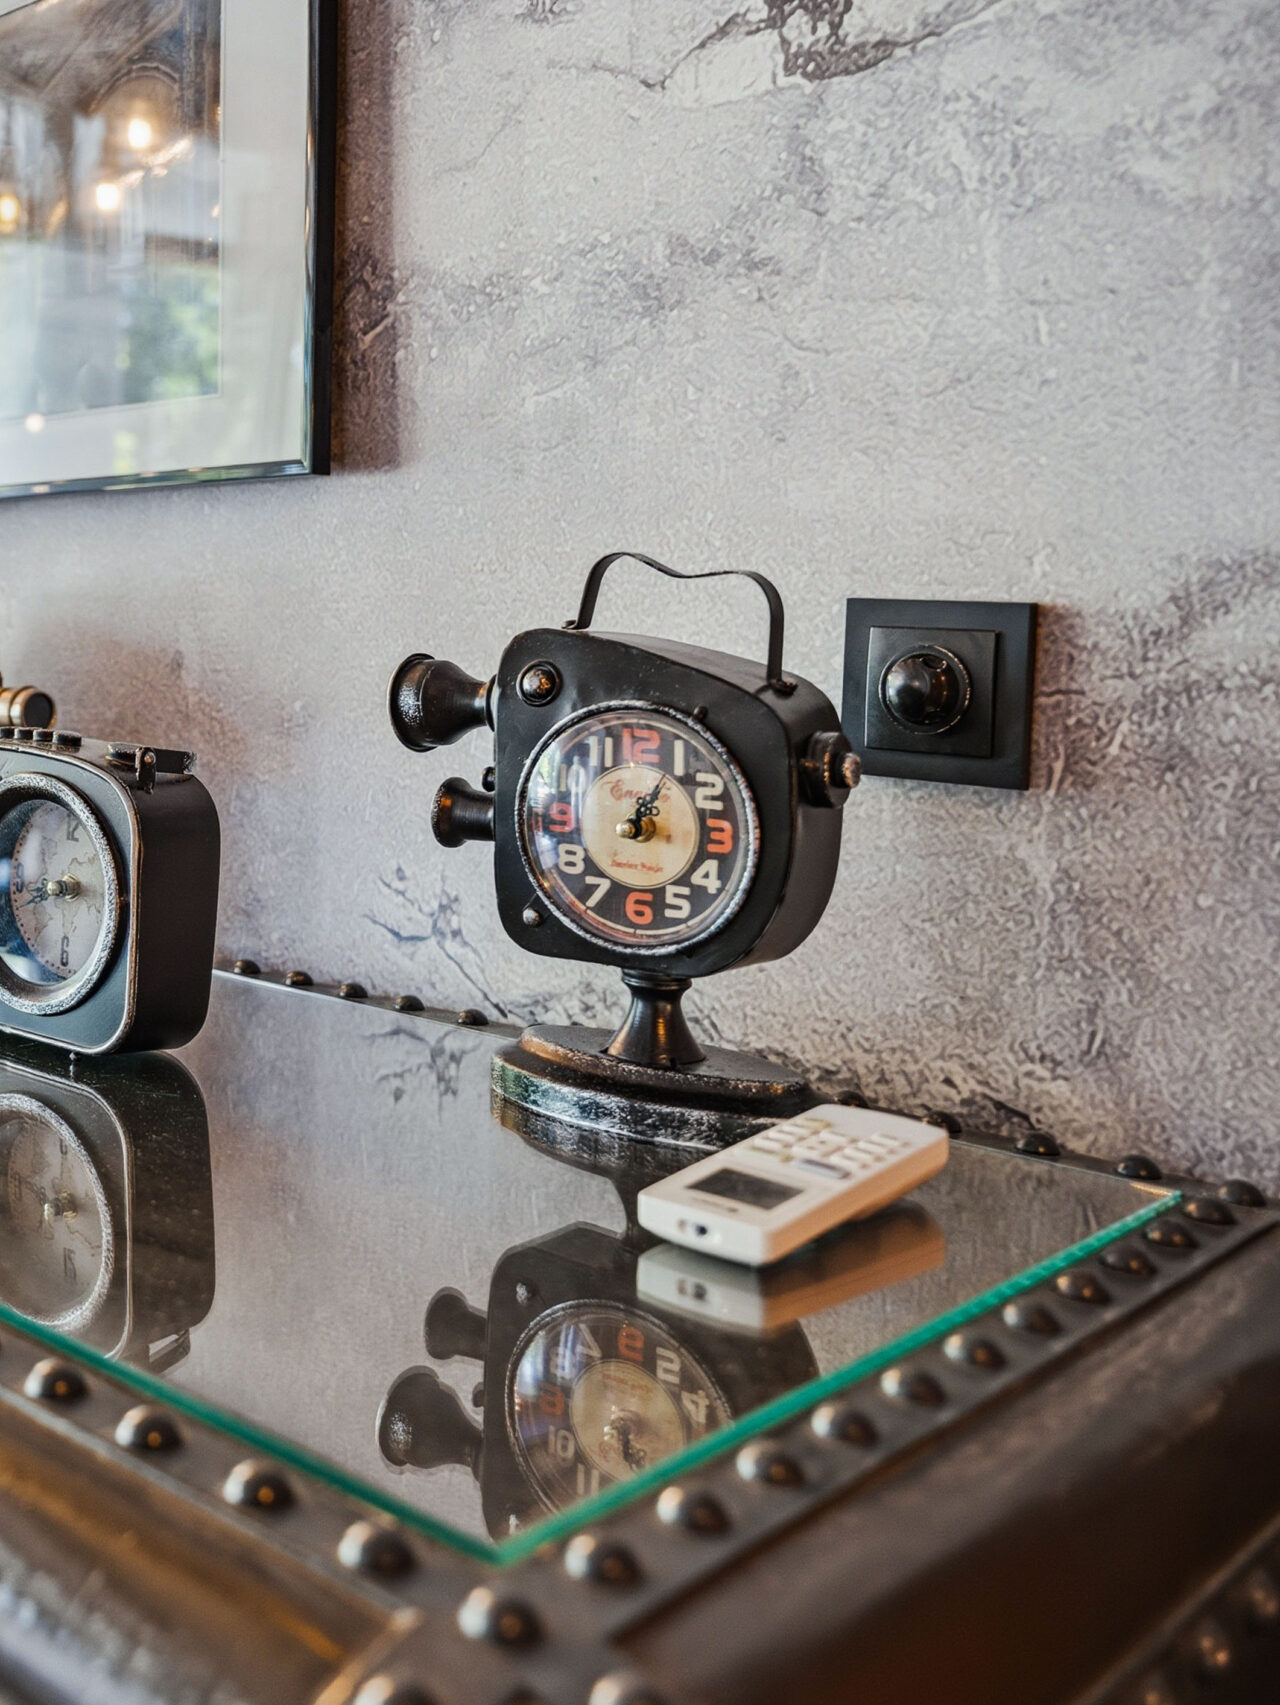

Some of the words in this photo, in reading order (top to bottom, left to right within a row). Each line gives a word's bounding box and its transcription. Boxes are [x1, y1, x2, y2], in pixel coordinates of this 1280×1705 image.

[586, 737, 613, 767] 11
[622, 728, 661, 762] 12
[674, 740, 685, 776] 1
[695, 773, 724, 810] 2
[549, 802, 573, 833] 9
[706, 819, 733, 853] 3
[558, 844, 586, 874] 8
[585, 876, 611, 908] 7
[691, 859, 721, 894] 4
[625, 892, 653, 925] 6
[664, 885, 692, 919] 5
